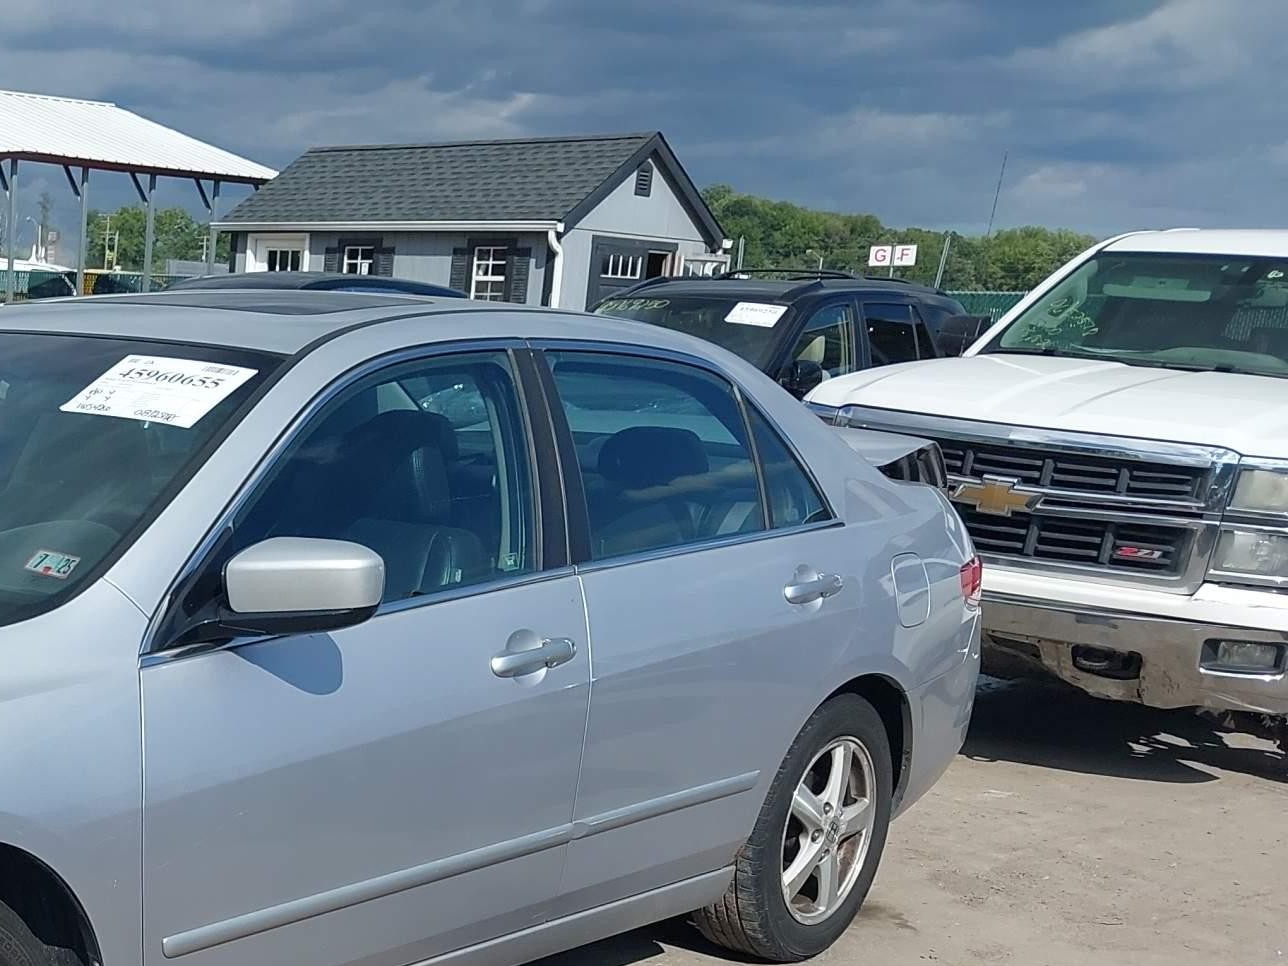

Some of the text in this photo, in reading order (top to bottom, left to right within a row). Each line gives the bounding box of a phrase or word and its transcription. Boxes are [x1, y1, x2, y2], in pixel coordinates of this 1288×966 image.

[874, 248, 887, 262] G
[900, 247, 912, 262] F
[119, 367, 225, 390] 45960655
[33, 553, 77, 575] 7 25
